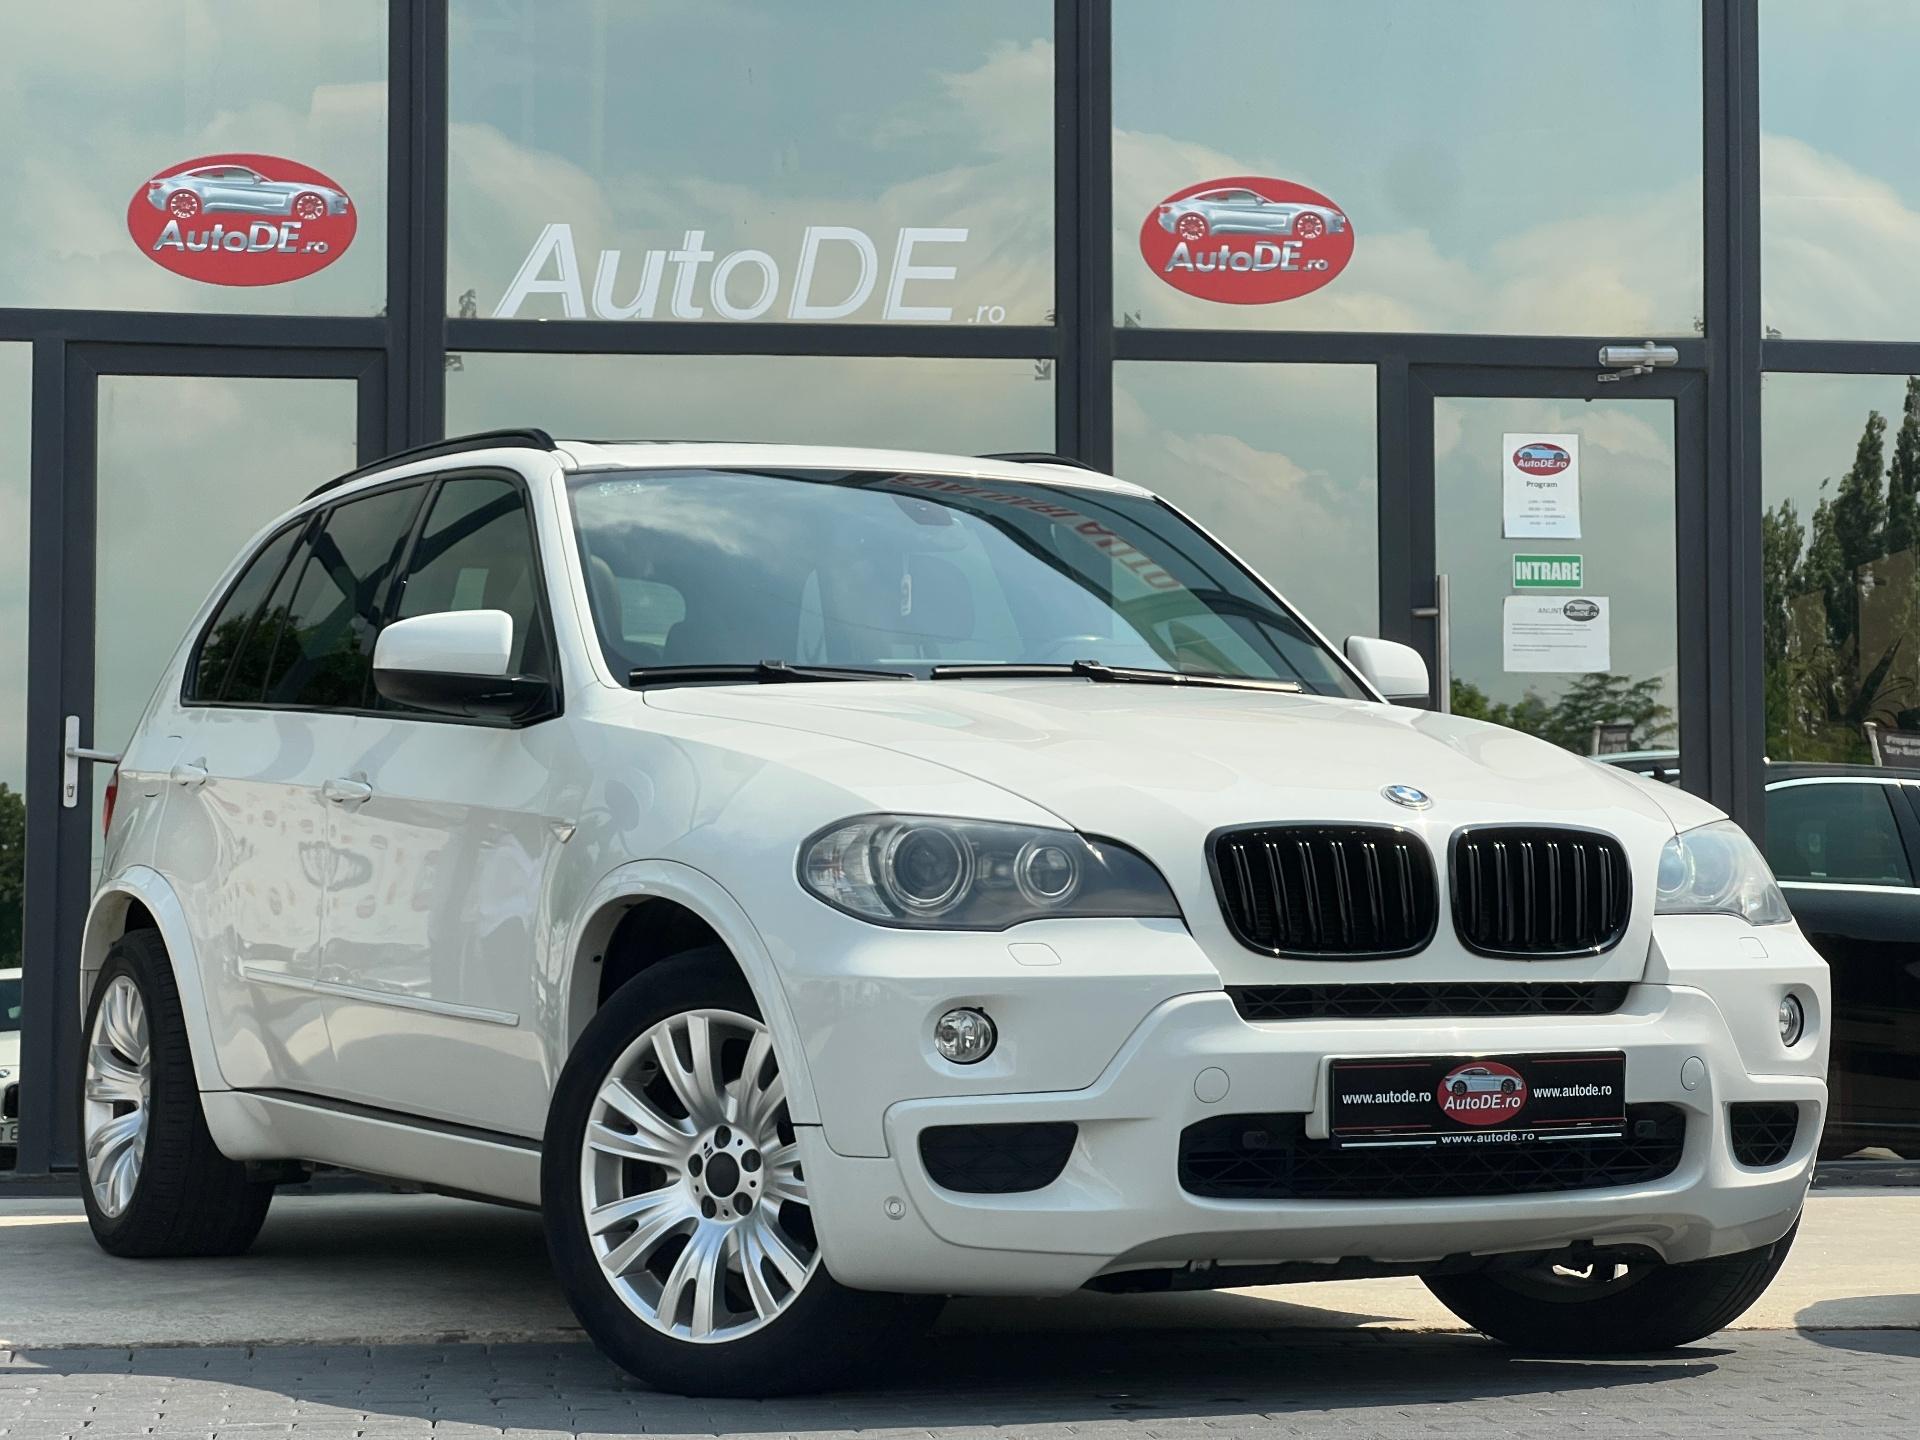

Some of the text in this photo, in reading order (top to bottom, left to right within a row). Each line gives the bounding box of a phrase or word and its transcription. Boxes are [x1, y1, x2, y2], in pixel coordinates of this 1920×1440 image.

[1526, 480, 1558, 489] Program
[1515, 561, 1580, 581] INTRARE
[1342, 1089, 1432, 1105] www.autode.ro
[1533, 1084, 1612, 1099] www.autode.ro
[1444, 1094, 1521, 1112] AutoDE.ro
[1441, 1131, 1535, 1145] www.autode.ro
